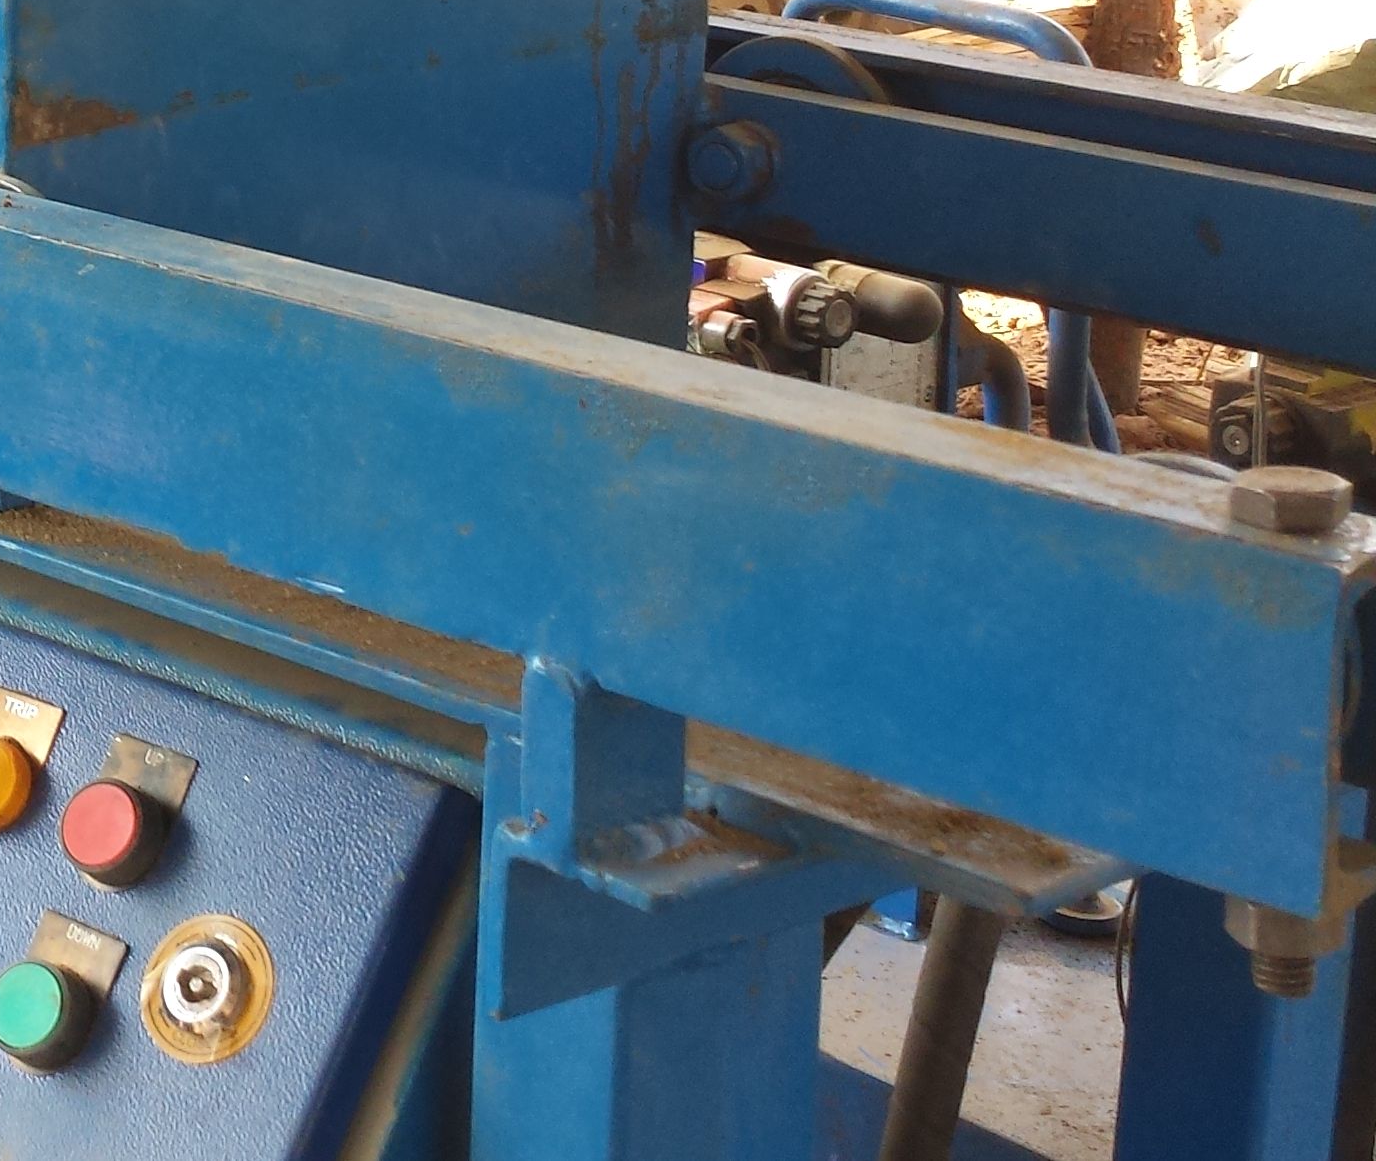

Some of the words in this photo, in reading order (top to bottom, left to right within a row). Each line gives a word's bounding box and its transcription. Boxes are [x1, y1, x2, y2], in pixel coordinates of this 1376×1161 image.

[5, 695, 40, 719] TRIP
[144, 748, 165, 767] UP
[66, 923, 101, 950] DOWN
